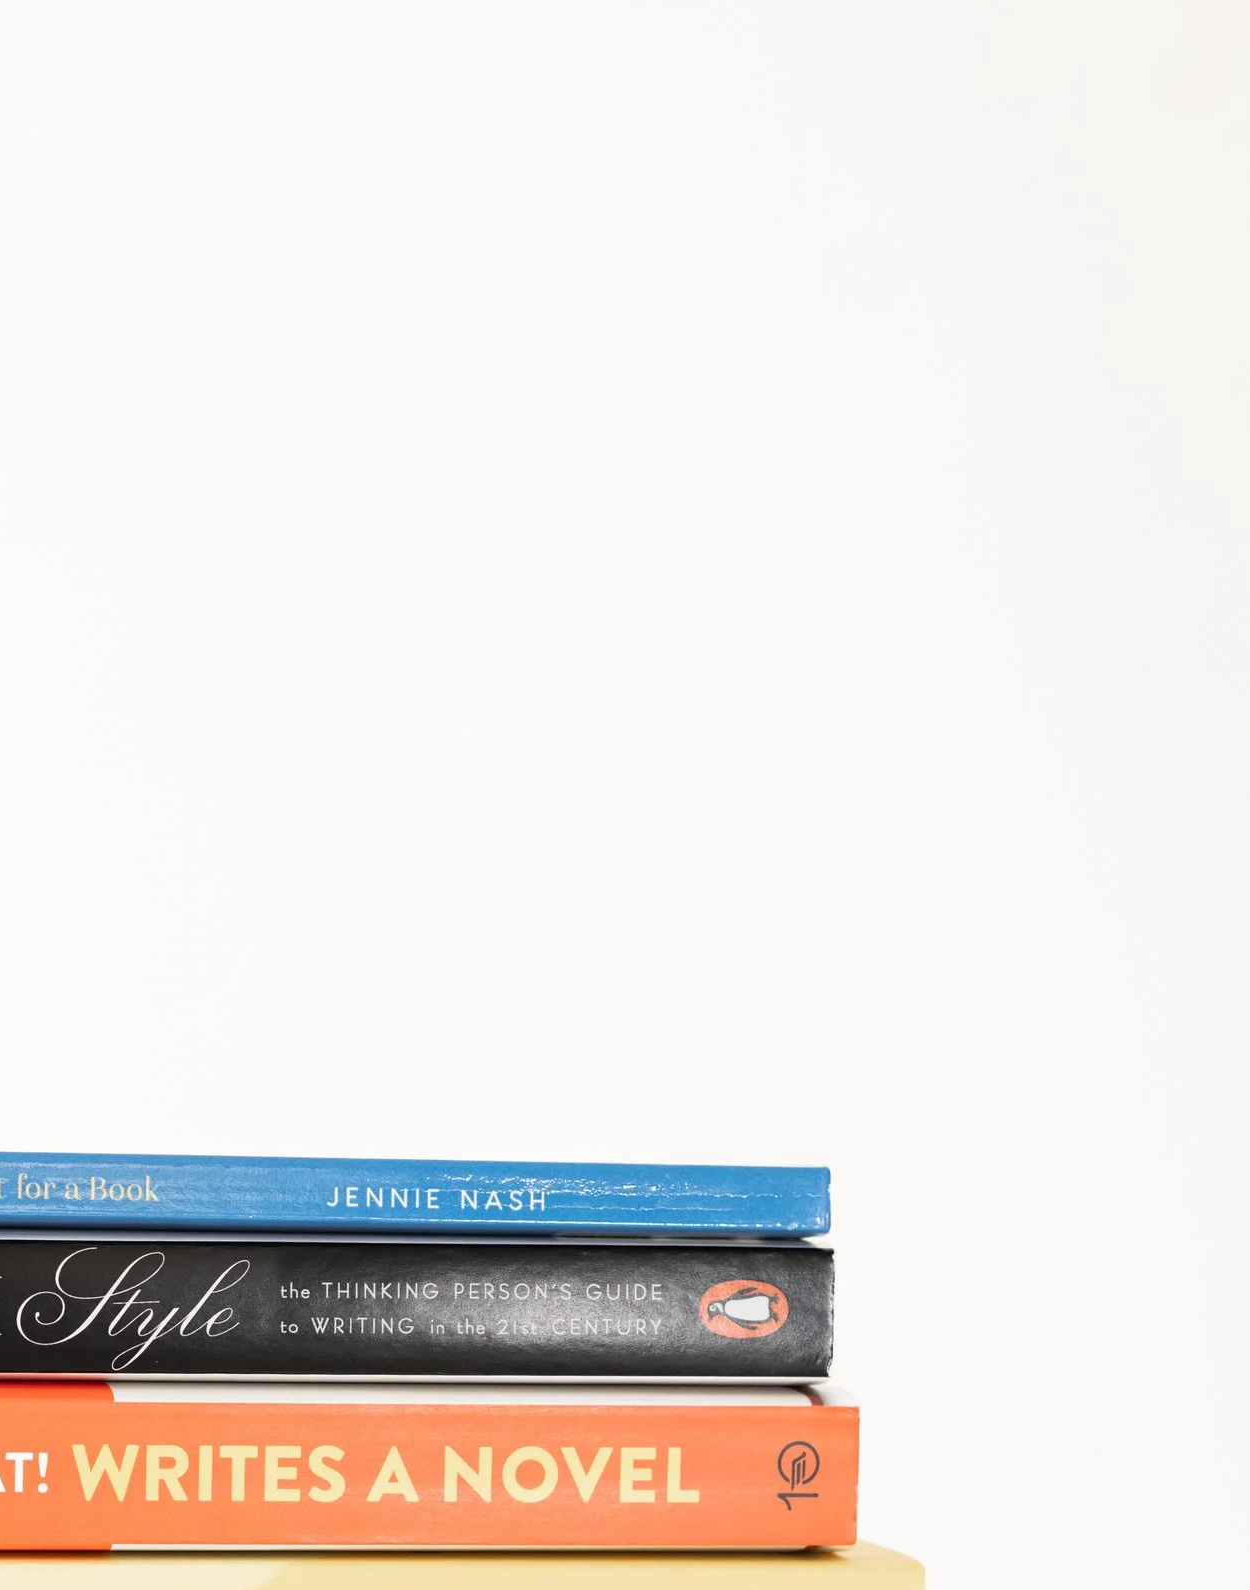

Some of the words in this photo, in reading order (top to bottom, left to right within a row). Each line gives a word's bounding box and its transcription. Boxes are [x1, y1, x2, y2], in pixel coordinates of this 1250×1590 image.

[16, 1171, 56, 1200] for
[63, 1182, 82, 1200] a
[89, 1175, 160, 1202] Book
[326, 1186, 440, 1209] JENNIE
[460, 1189, 549, 1212] NASH
[280, 1281, 311, 1300] the
[321, 1282, 440, 1301] THINKING
[453, 1282, 572, 1302] PERSON'S
[586, 1283, 664, 1302] GUIDE
[16, 1246, 252, 1371] Style
[280, 1320, 299, 1334] to
[311, 1317, 415, 1335] WRITING
[430, 1319, 445, 1334] in
[456, 1317, 487, 1335] the
[497, 1319, 538, 1336] 21st
[552, 1317, 663, 1336] CENTURY
[72, 1443, 346, 1503] WRITES
[366, 1445, 420, 1503] A
[443, 1445, 701, 1504] NOVEL
